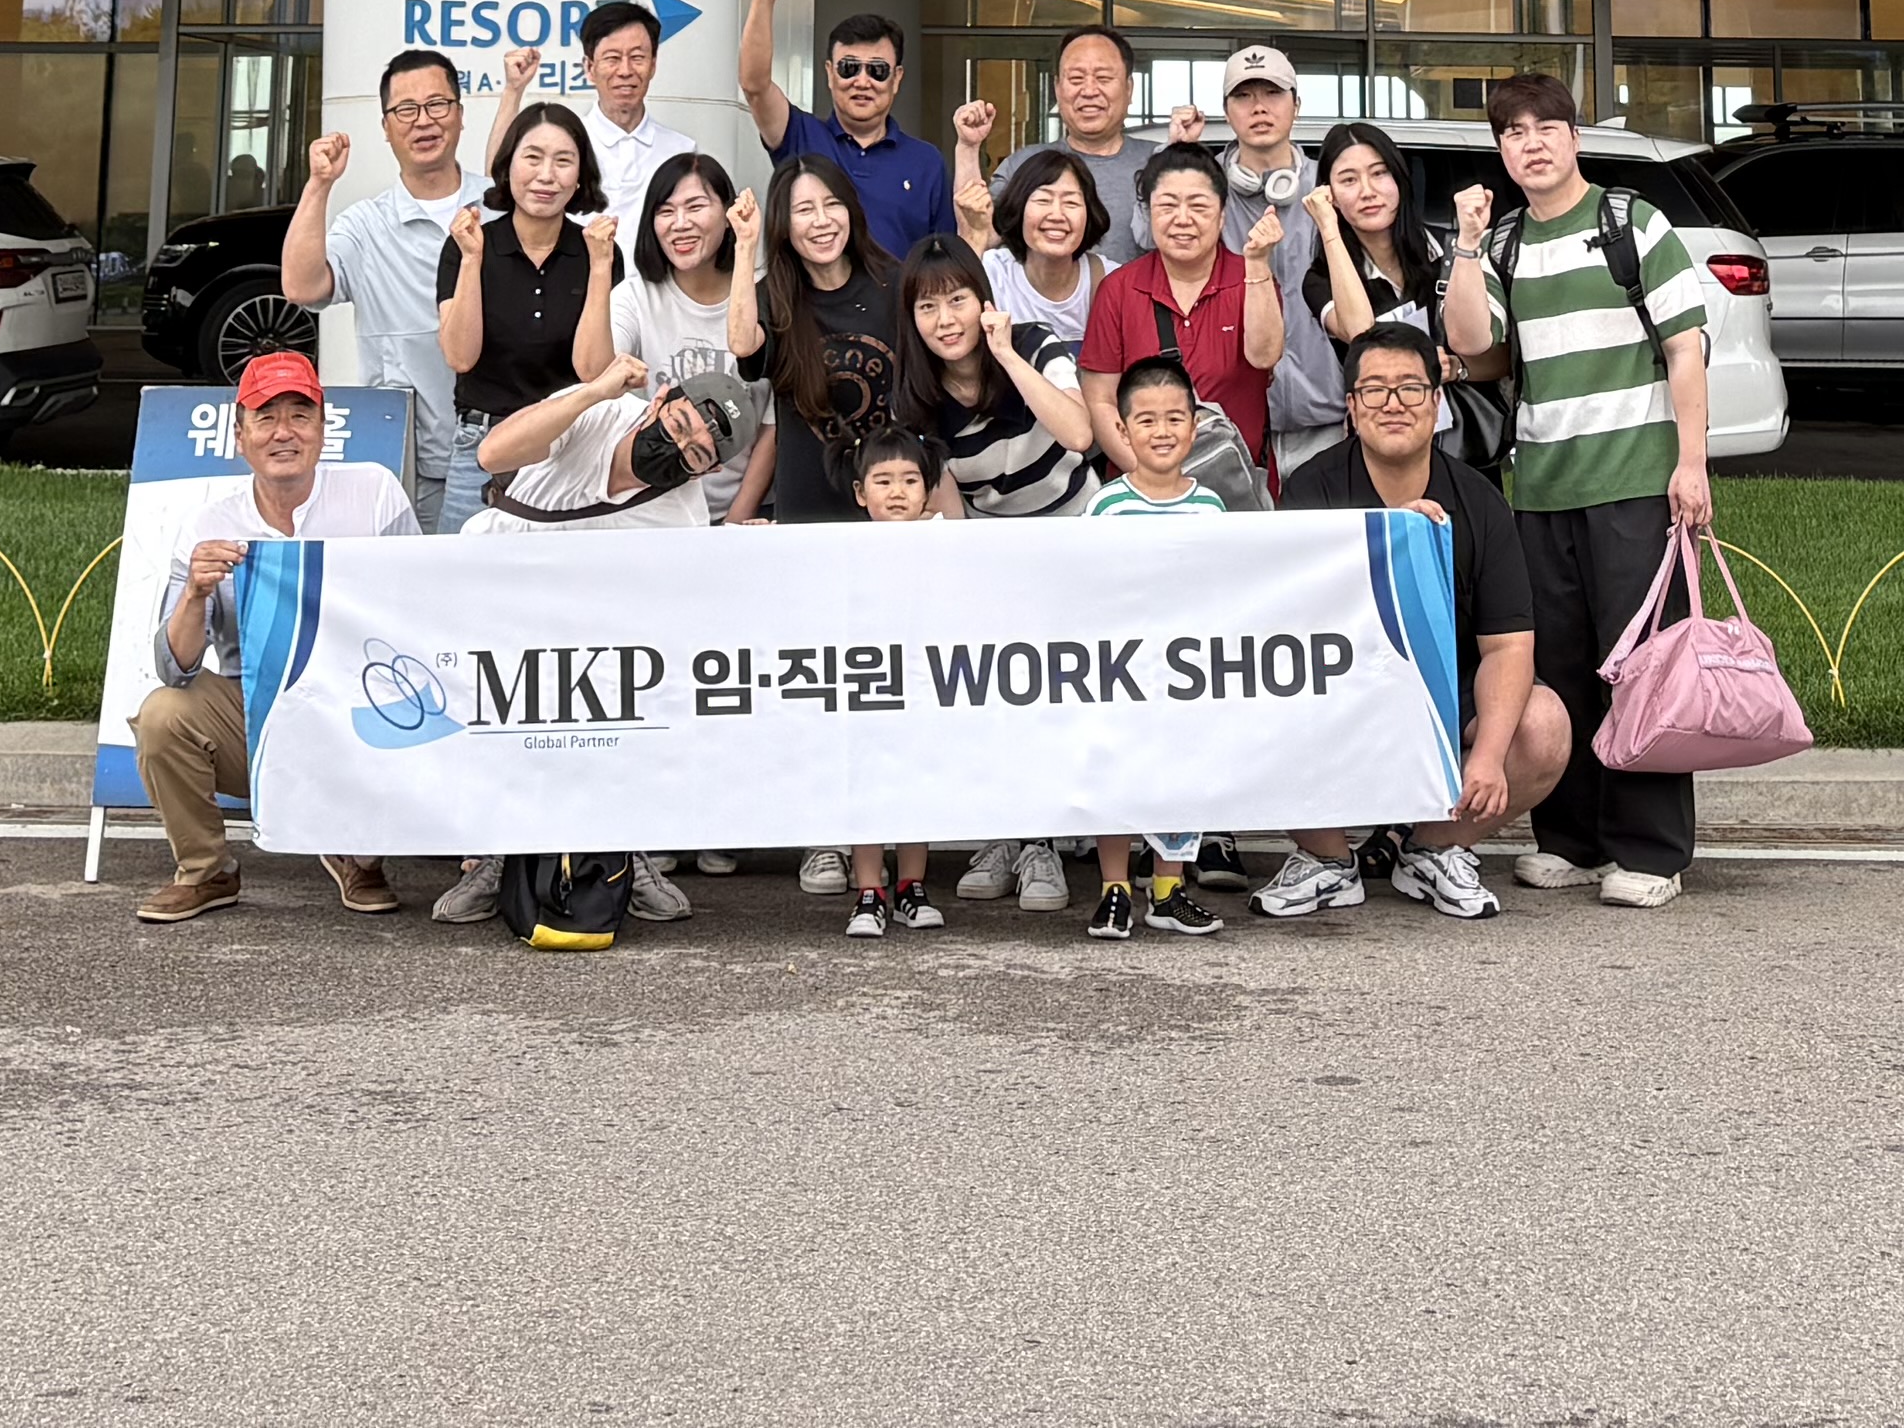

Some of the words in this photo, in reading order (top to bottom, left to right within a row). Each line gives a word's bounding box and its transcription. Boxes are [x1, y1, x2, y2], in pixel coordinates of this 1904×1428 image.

[539, 60, 596, 96] 리조
[187, 402, 352, 461] 웨홀
[467, 645, 665, 726] MKP
[691, 643, 905, 716] 임·직원
[925, 638, 1146, 707] WORK
[1166, 632, 1354, 702] SHOP
[524, 735, 567, 750] Global
[570, 734, 620, 749] Partner
